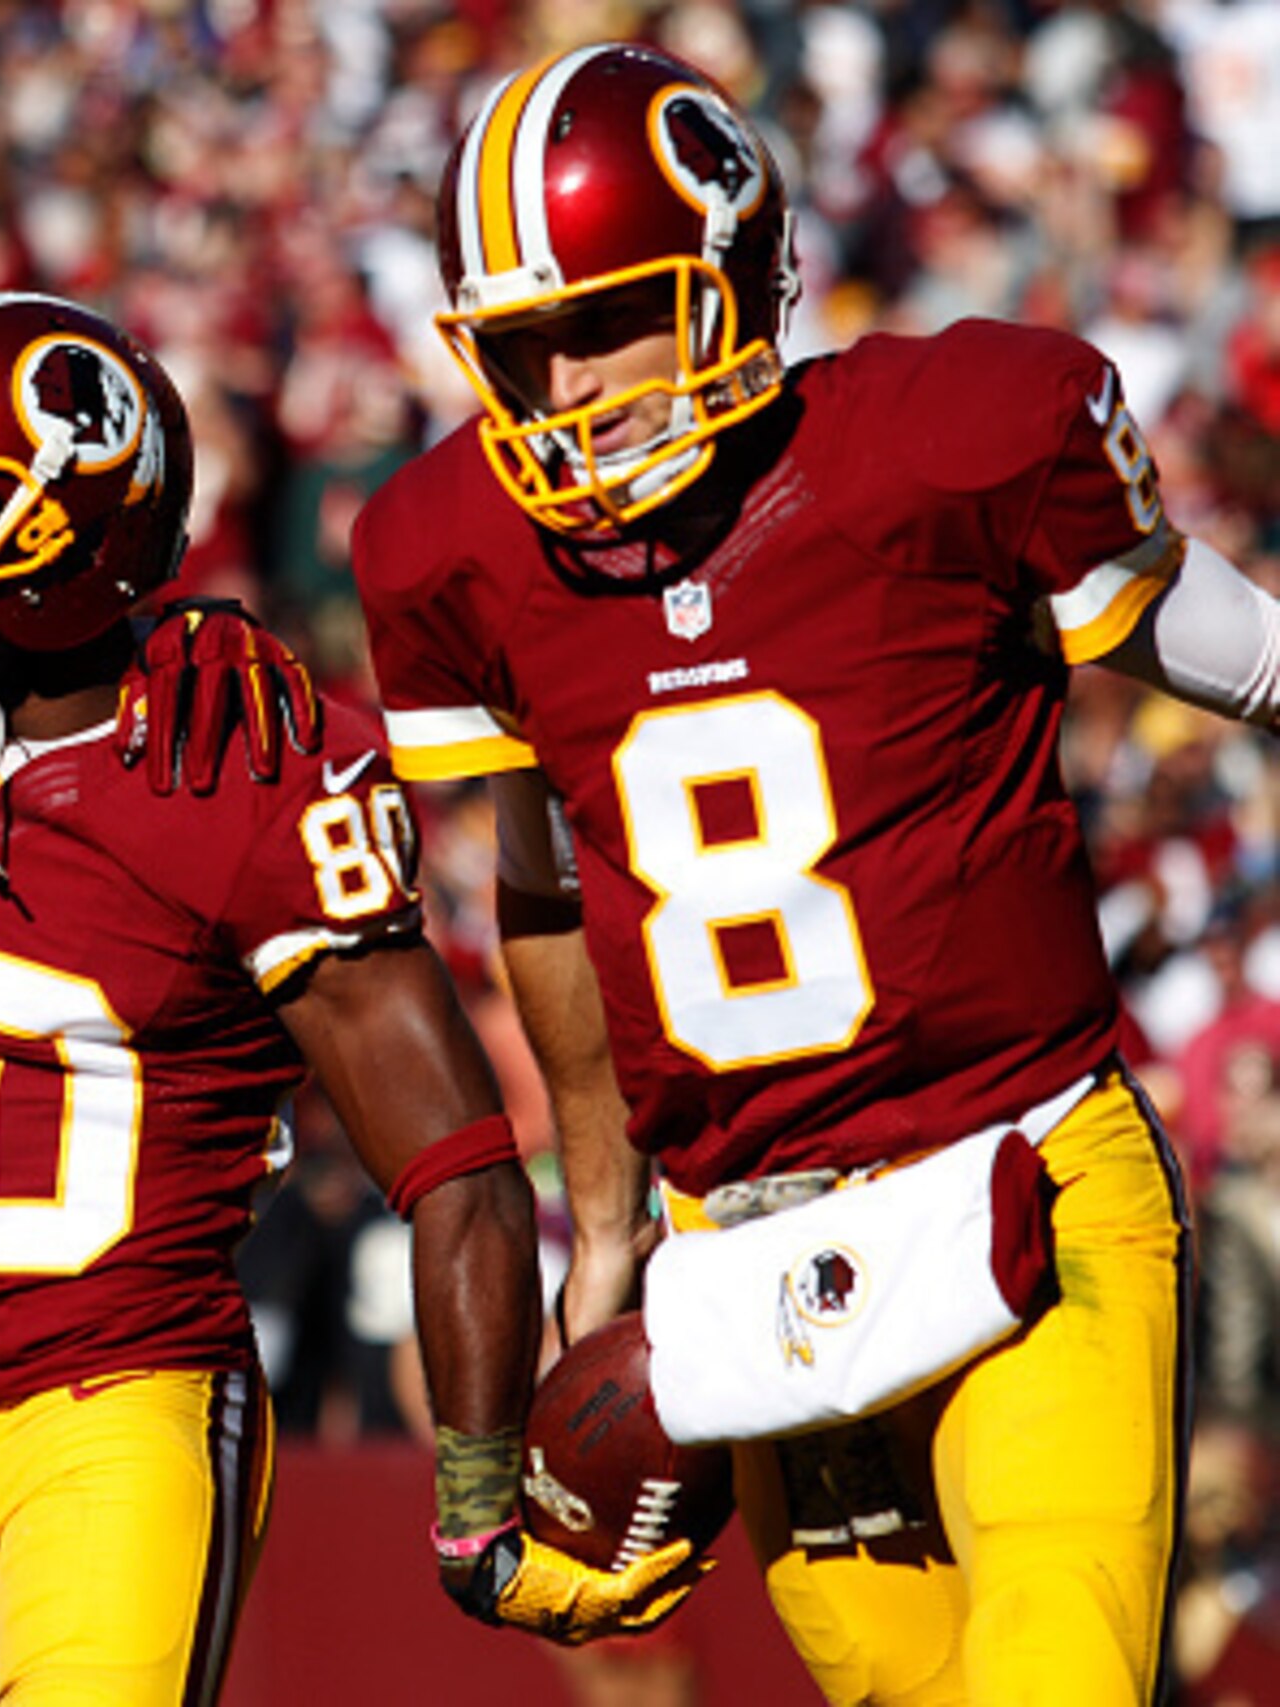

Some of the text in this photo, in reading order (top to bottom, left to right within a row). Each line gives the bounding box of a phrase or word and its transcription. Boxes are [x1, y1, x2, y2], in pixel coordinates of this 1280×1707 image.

[1104, 402, 1164, 535] 8
[299, 783, 418, 919] 80
[612, 689, 876, 1073] 8
